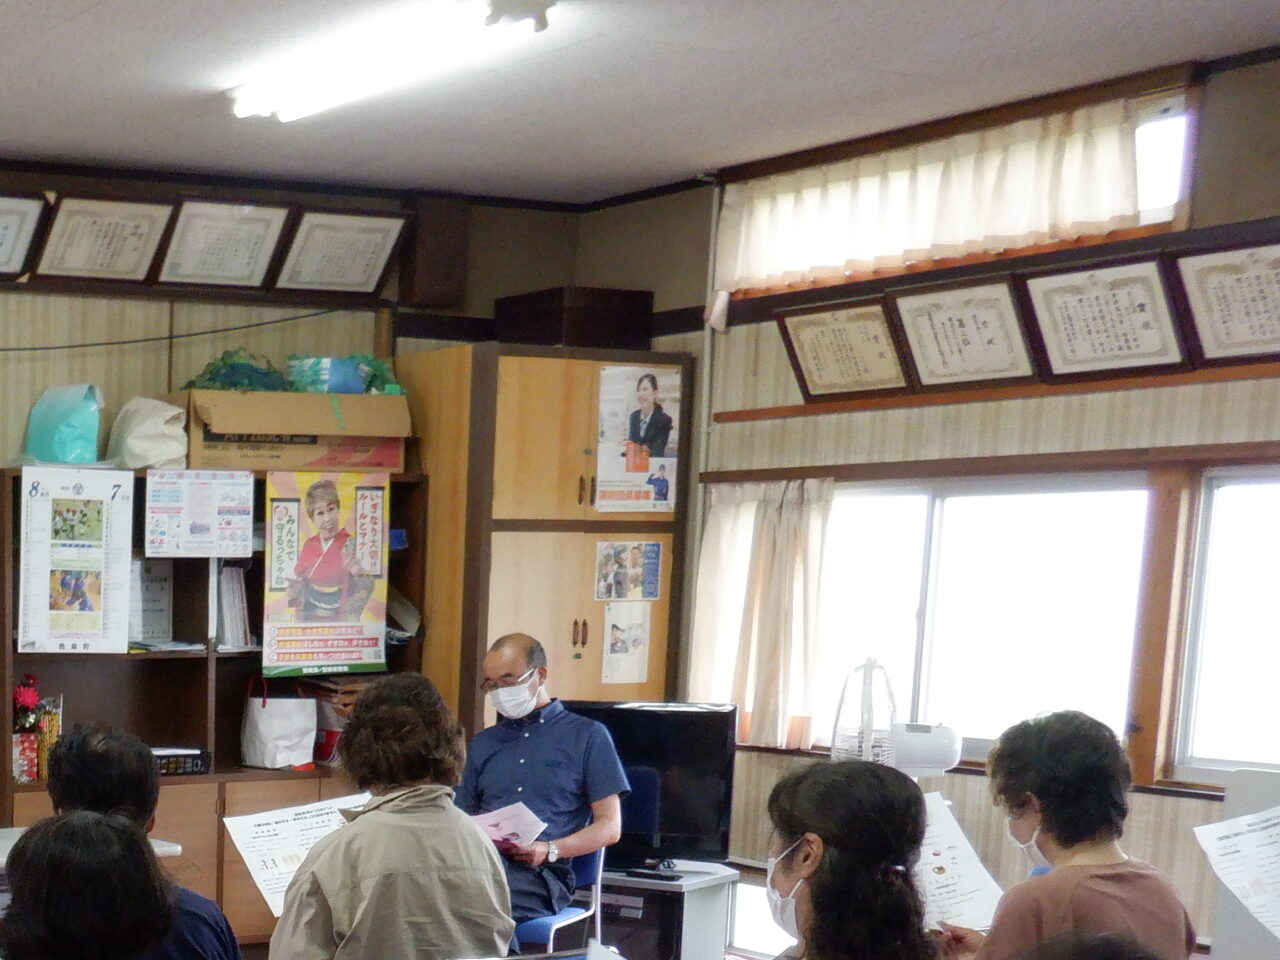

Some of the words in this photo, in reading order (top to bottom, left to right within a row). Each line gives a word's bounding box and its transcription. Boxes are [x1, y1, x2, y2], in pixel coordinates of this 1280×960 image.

[29, 481, 40, 497] 8
[111, 484, 121, 500] 7
[286, 514, 296, 562] みんなで
